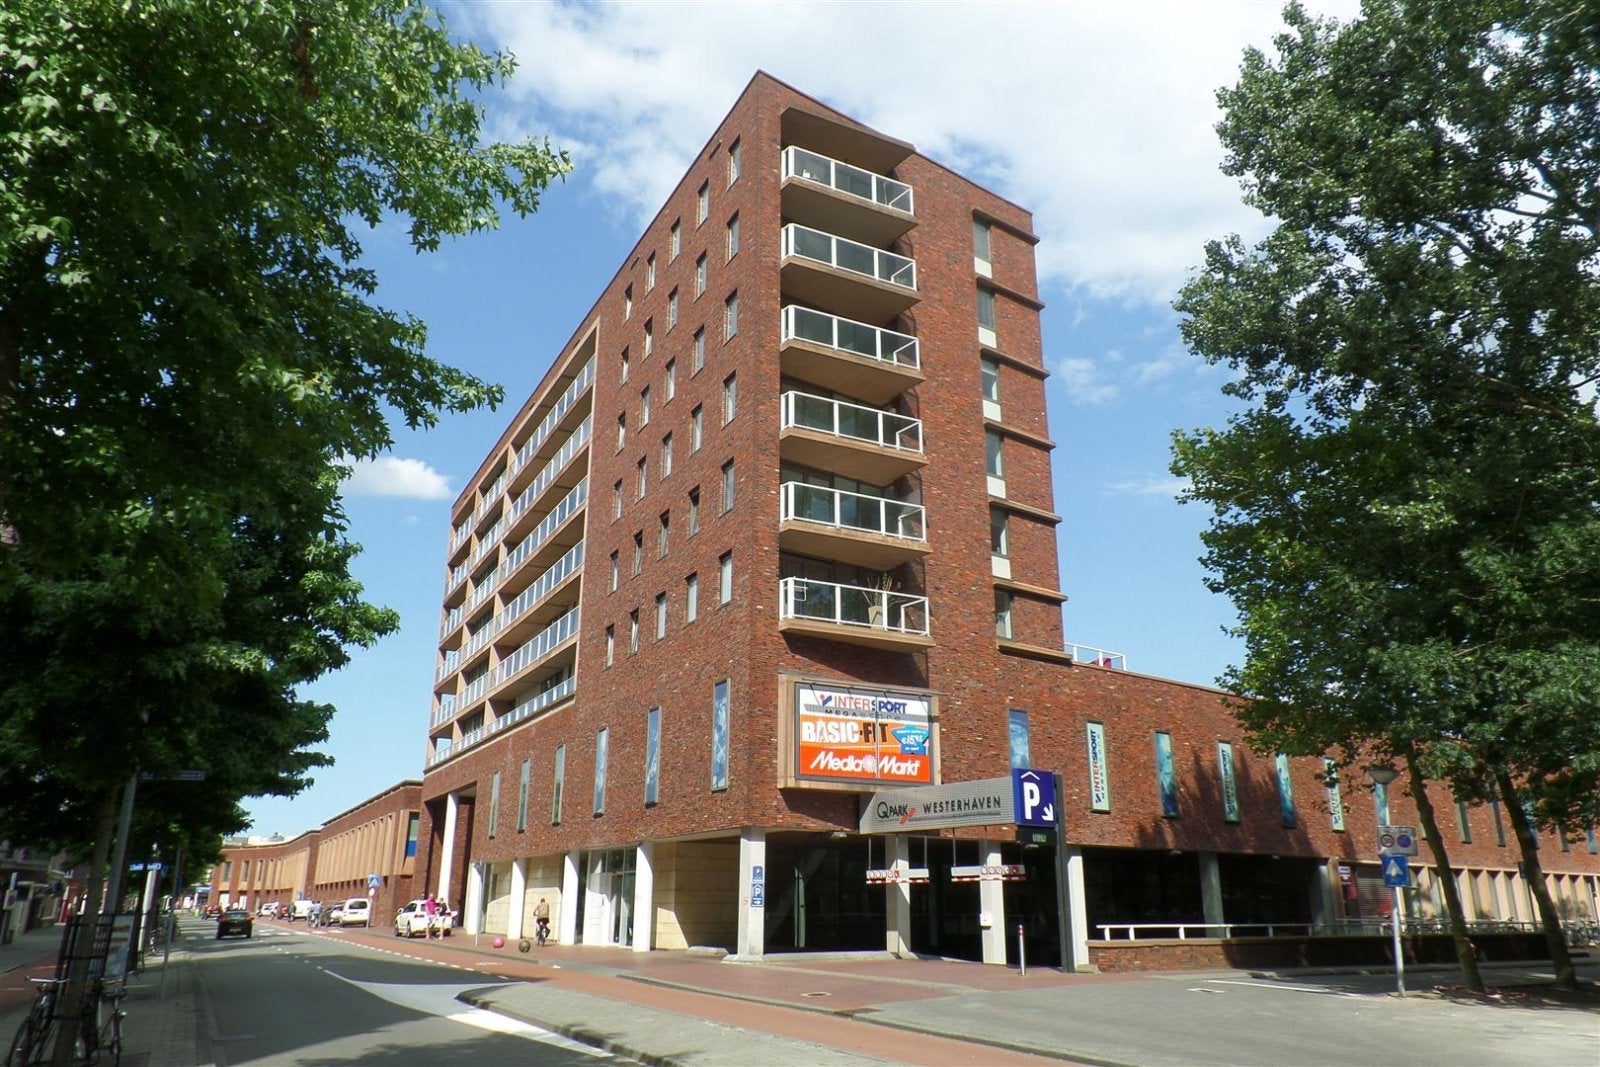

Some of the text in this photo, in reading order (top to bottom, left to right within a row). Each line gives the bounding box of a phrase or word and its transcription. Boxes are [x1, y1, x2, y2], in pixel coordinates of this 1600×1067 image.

[834, 695, 907, 714] INTERSPORT
[810, 751, 921, 776] Media Markt
[1091, 729, 1100, 792] INTERSPORT
[923, 796, 1001, 814] WESTERHAVEN
[1023, 782, 1040, 820] P
